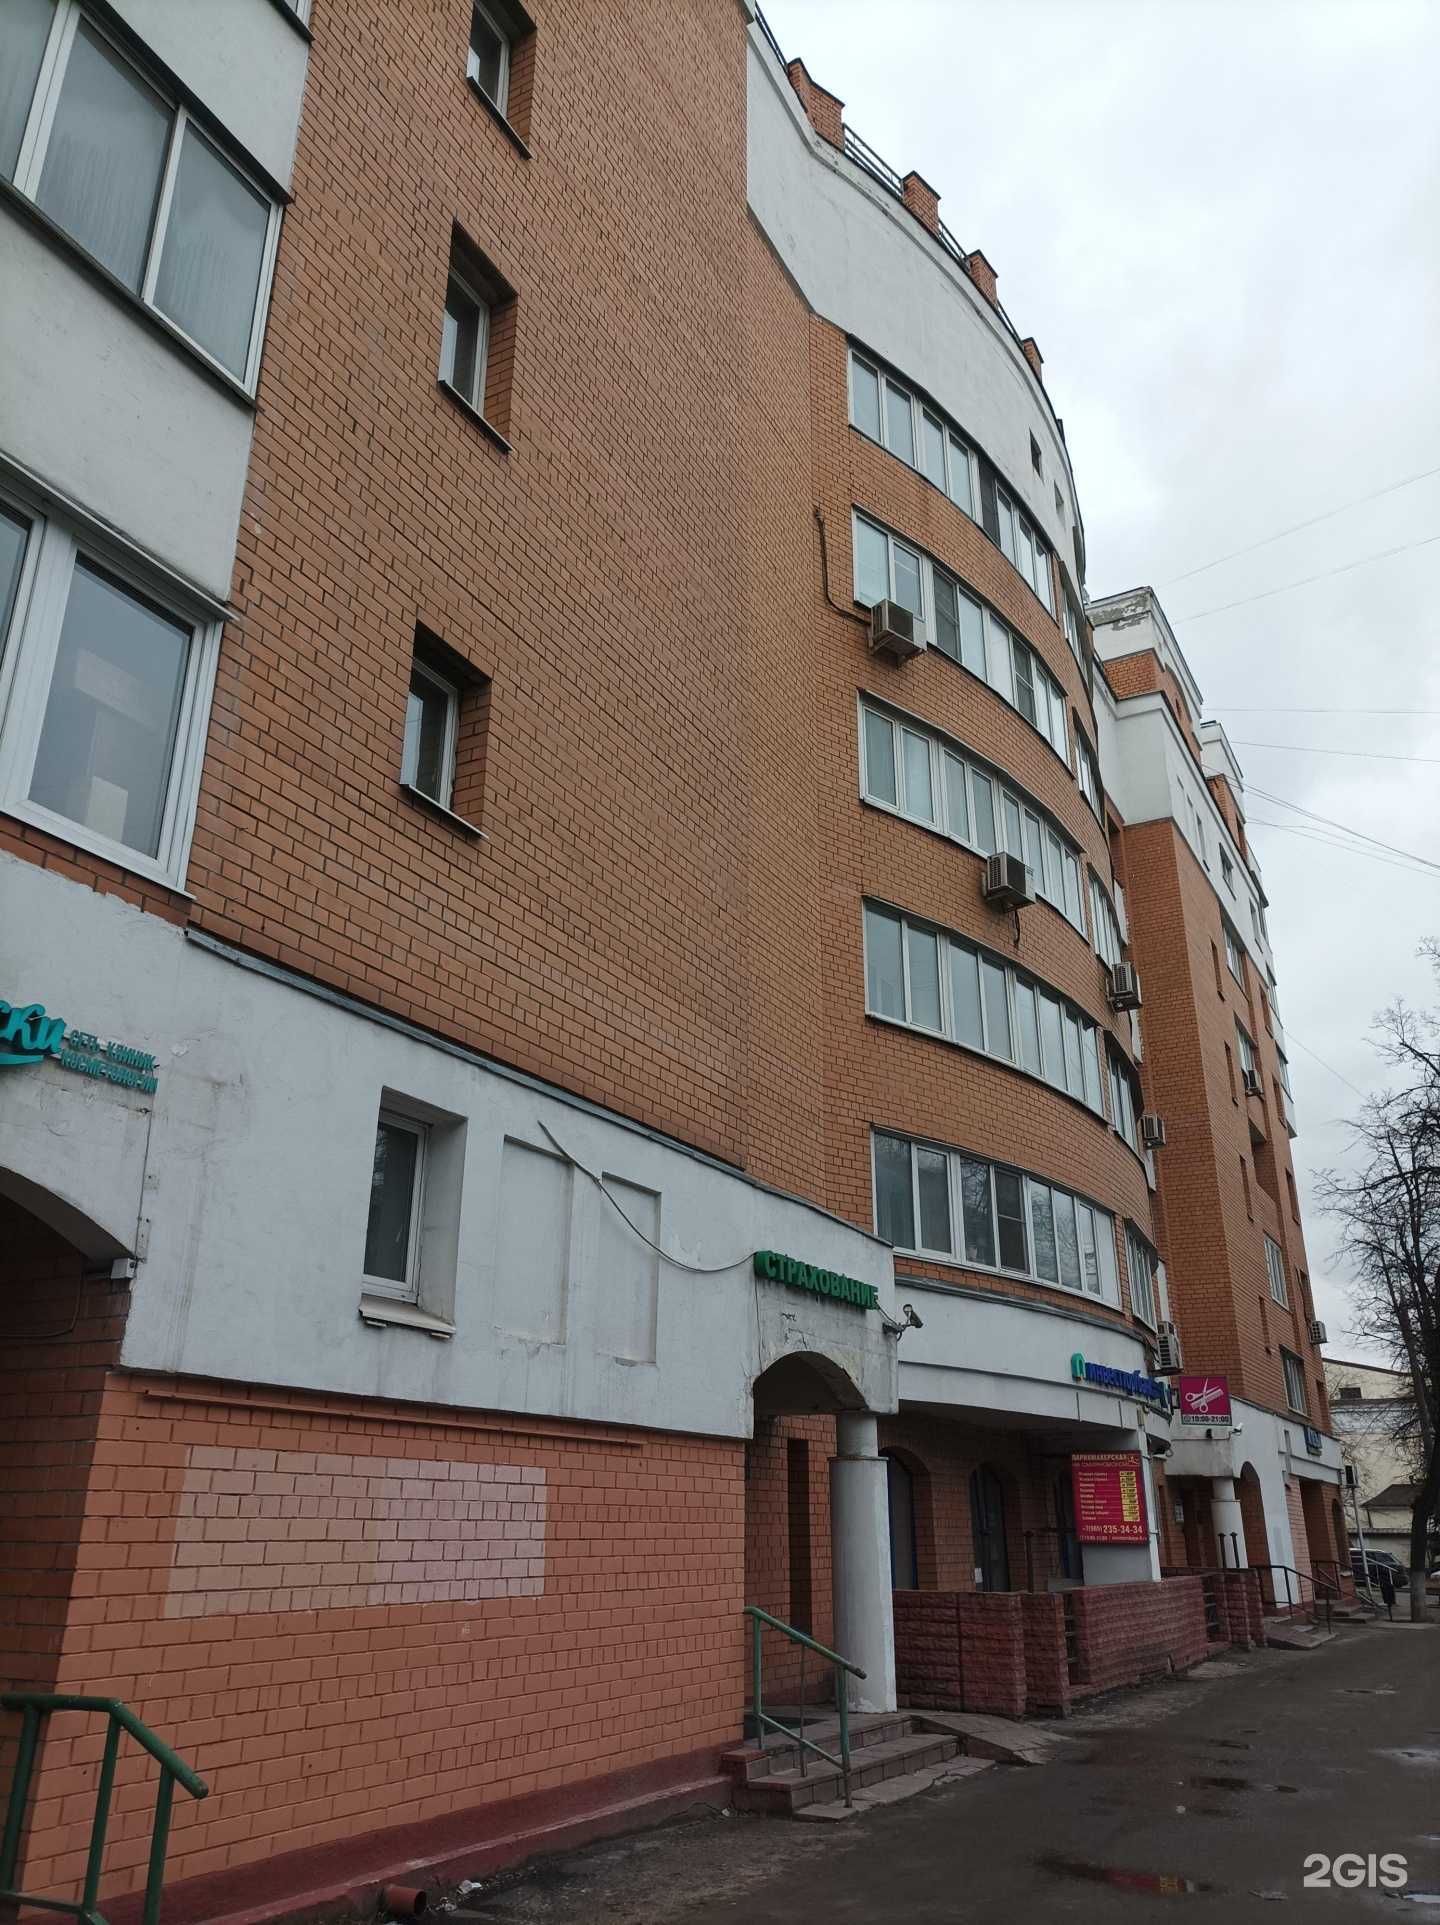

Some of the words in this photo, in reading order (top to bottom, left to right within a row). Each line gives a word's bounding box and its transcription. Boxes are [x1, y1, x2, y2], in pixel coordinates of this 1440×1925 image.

[70, 1030, 100, 1053] СЕТЬ
[106, 1041, 157, 1069] КЛИНИК
[61, 1049, 158, 1094] КОСМЕТОЛОГИИ
[756, 1250, 879, 1310] СТРАХОВАНИЕ
[1103, 1525, 1143, 1533] 235-34-34
